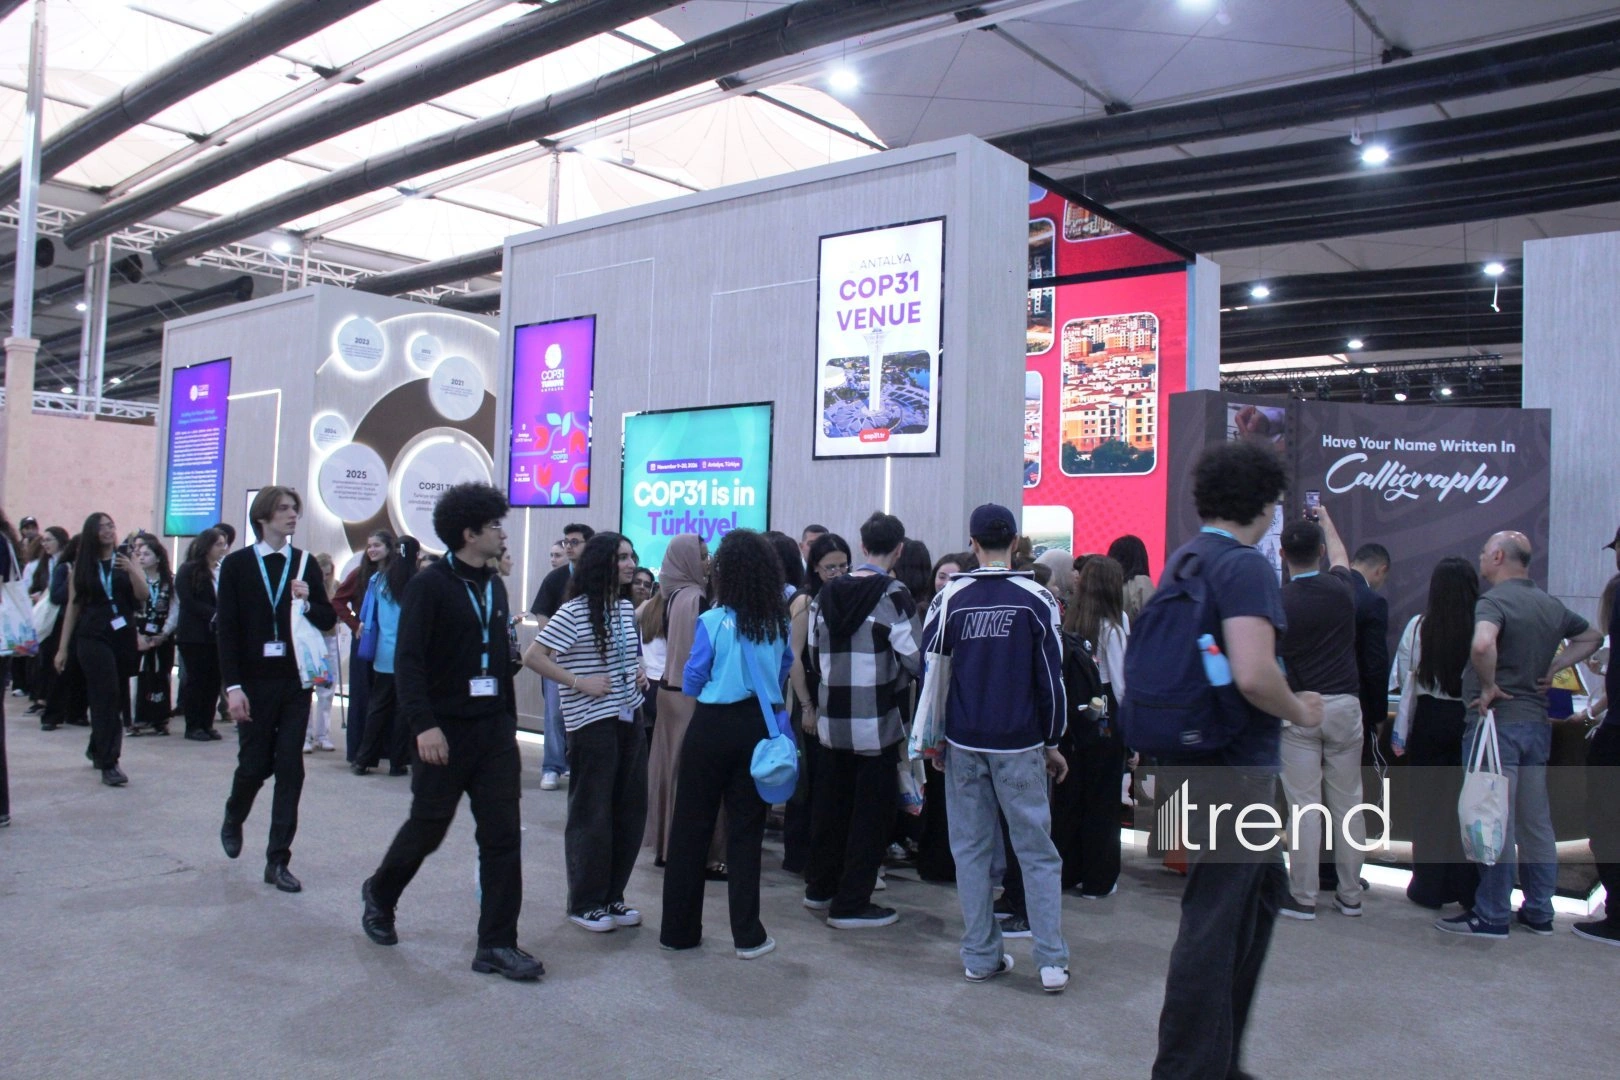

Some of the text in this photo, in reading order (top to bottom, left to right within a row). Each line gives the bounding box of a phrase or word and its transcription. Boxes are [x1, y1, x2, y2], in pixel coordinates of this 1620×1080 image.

[860, 253, 912, 269] ANTALYA
[839, 270, 919, 301] COP31
[836, 301, 921, 331] VENUE
[1322, 435, 1516, 453] Have Your Name Written In
[346, 469, 367, 480] 2025
[418, 481, 444, 491] COP31
[1325, 452, 1509, 504] Calligraphy
[634, 478, 755, 507] COP31 is in
[961, 609, 1017, 640] NIKE
